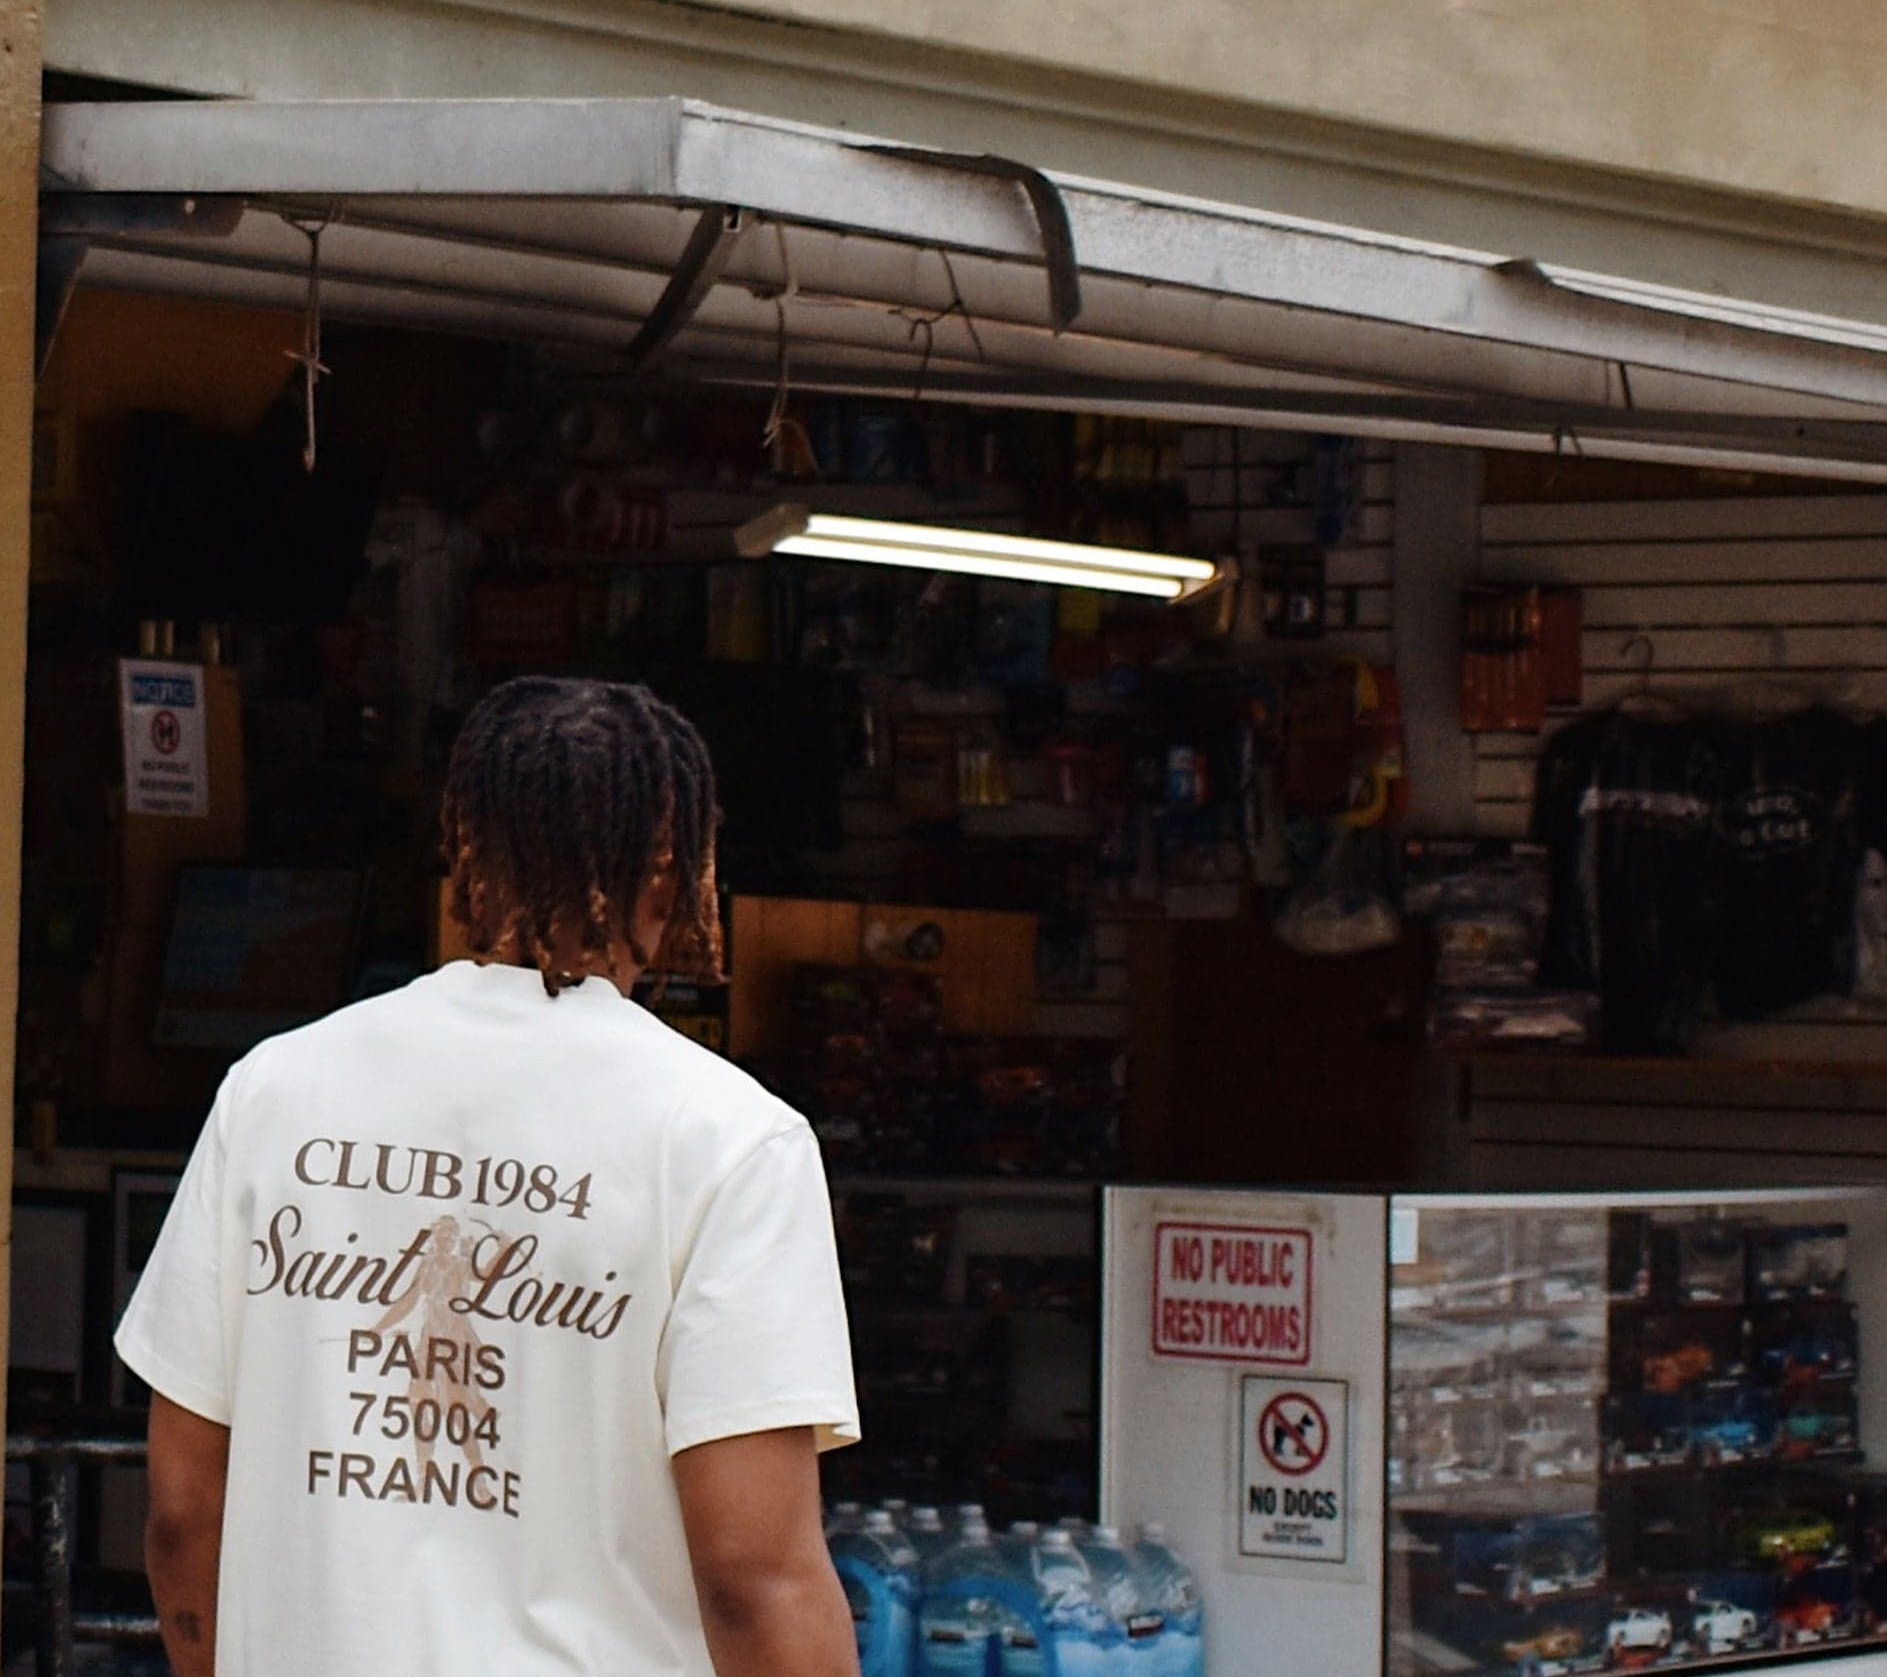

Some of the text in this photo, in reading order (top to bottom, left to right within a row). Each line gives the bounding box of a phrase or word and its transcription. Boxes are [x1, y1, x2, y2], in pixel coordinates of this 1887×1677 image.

[294, 1137, 594, 1220] CLUB 1984
[246, 1204, 633, 1340] Saint Louis
[1170, 1236, 1294, 1288] NO PUBLIC
[1162, 1298, 1300, 1353] RESTROOMS
[346, 1329, 507, 1390] PARIS
[348, 1391, 502, 1449] 75004
[306, 1450, 521, 1518] FRANCE
[1249, 1485, 1338, 1520] NO DOGS
